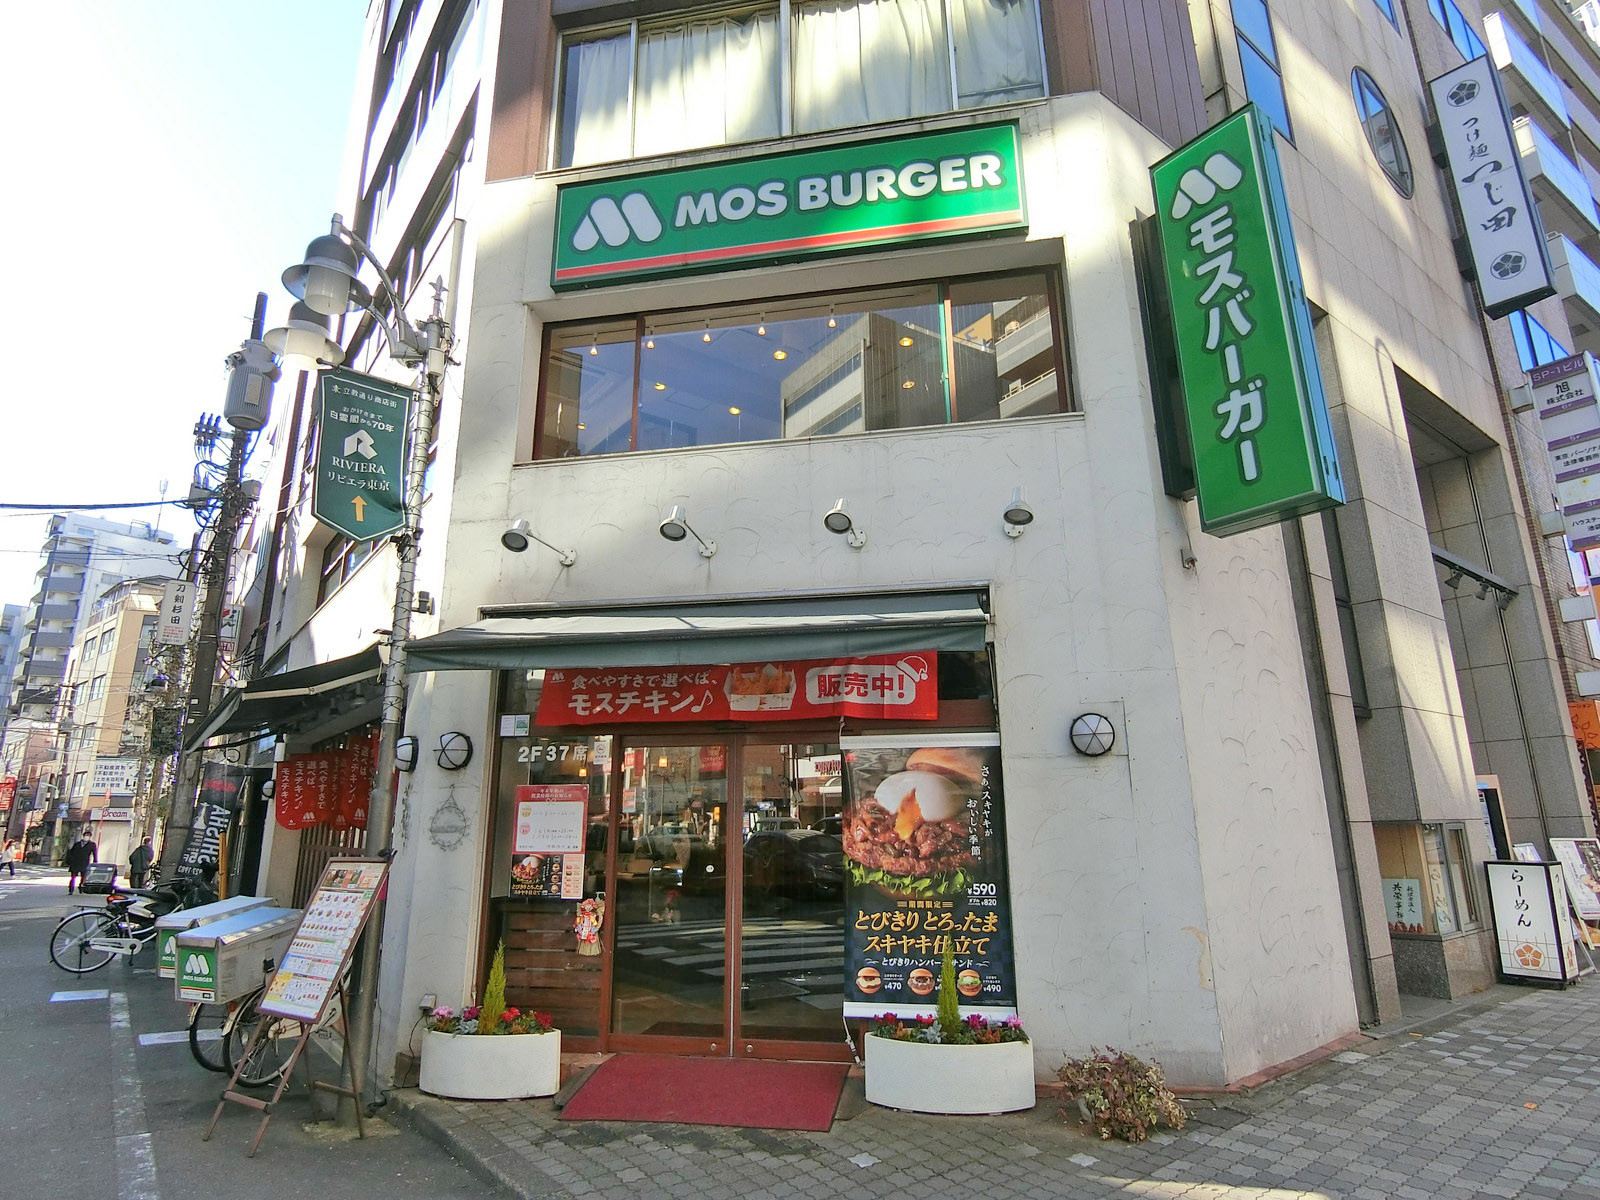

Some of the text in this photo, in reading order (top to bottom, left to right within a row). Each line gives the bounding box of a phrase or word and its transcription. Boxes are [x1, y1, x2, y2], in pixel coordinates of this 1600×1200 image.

[1461, 117, 1517, 233] つけ麺 つじ田
[674, 153, 1002, 228] MOS BURGER
[1190, 205, 1264, 482] モスバーガー
[1533, 360, 1584, 382] SP-1ビル
[1546, 389, 1584, 405] 株式会社
[1555, 381, 1570, 395] 旭
[332, 456, 387, 475] RIVIERA
[328, 471, 391, 492] リビエラ東京
[571, 671, 717, 691] 食べやすさで選べば、
[817, 672, 905, 699] 販売中!
[518, 747, 543, 762] 2F
[966, 798, 982, 861] おいしい季節。
[908, 900, 941, 909] 期間限定
[1511, 868, 1532, 928] らーめん
[854, 910, 998, 933] とびきり とろったま
[863, 934, 990, 956] スキヤキ仕立て
[881, 957, 973, 968] とびきりハンバーサンド
